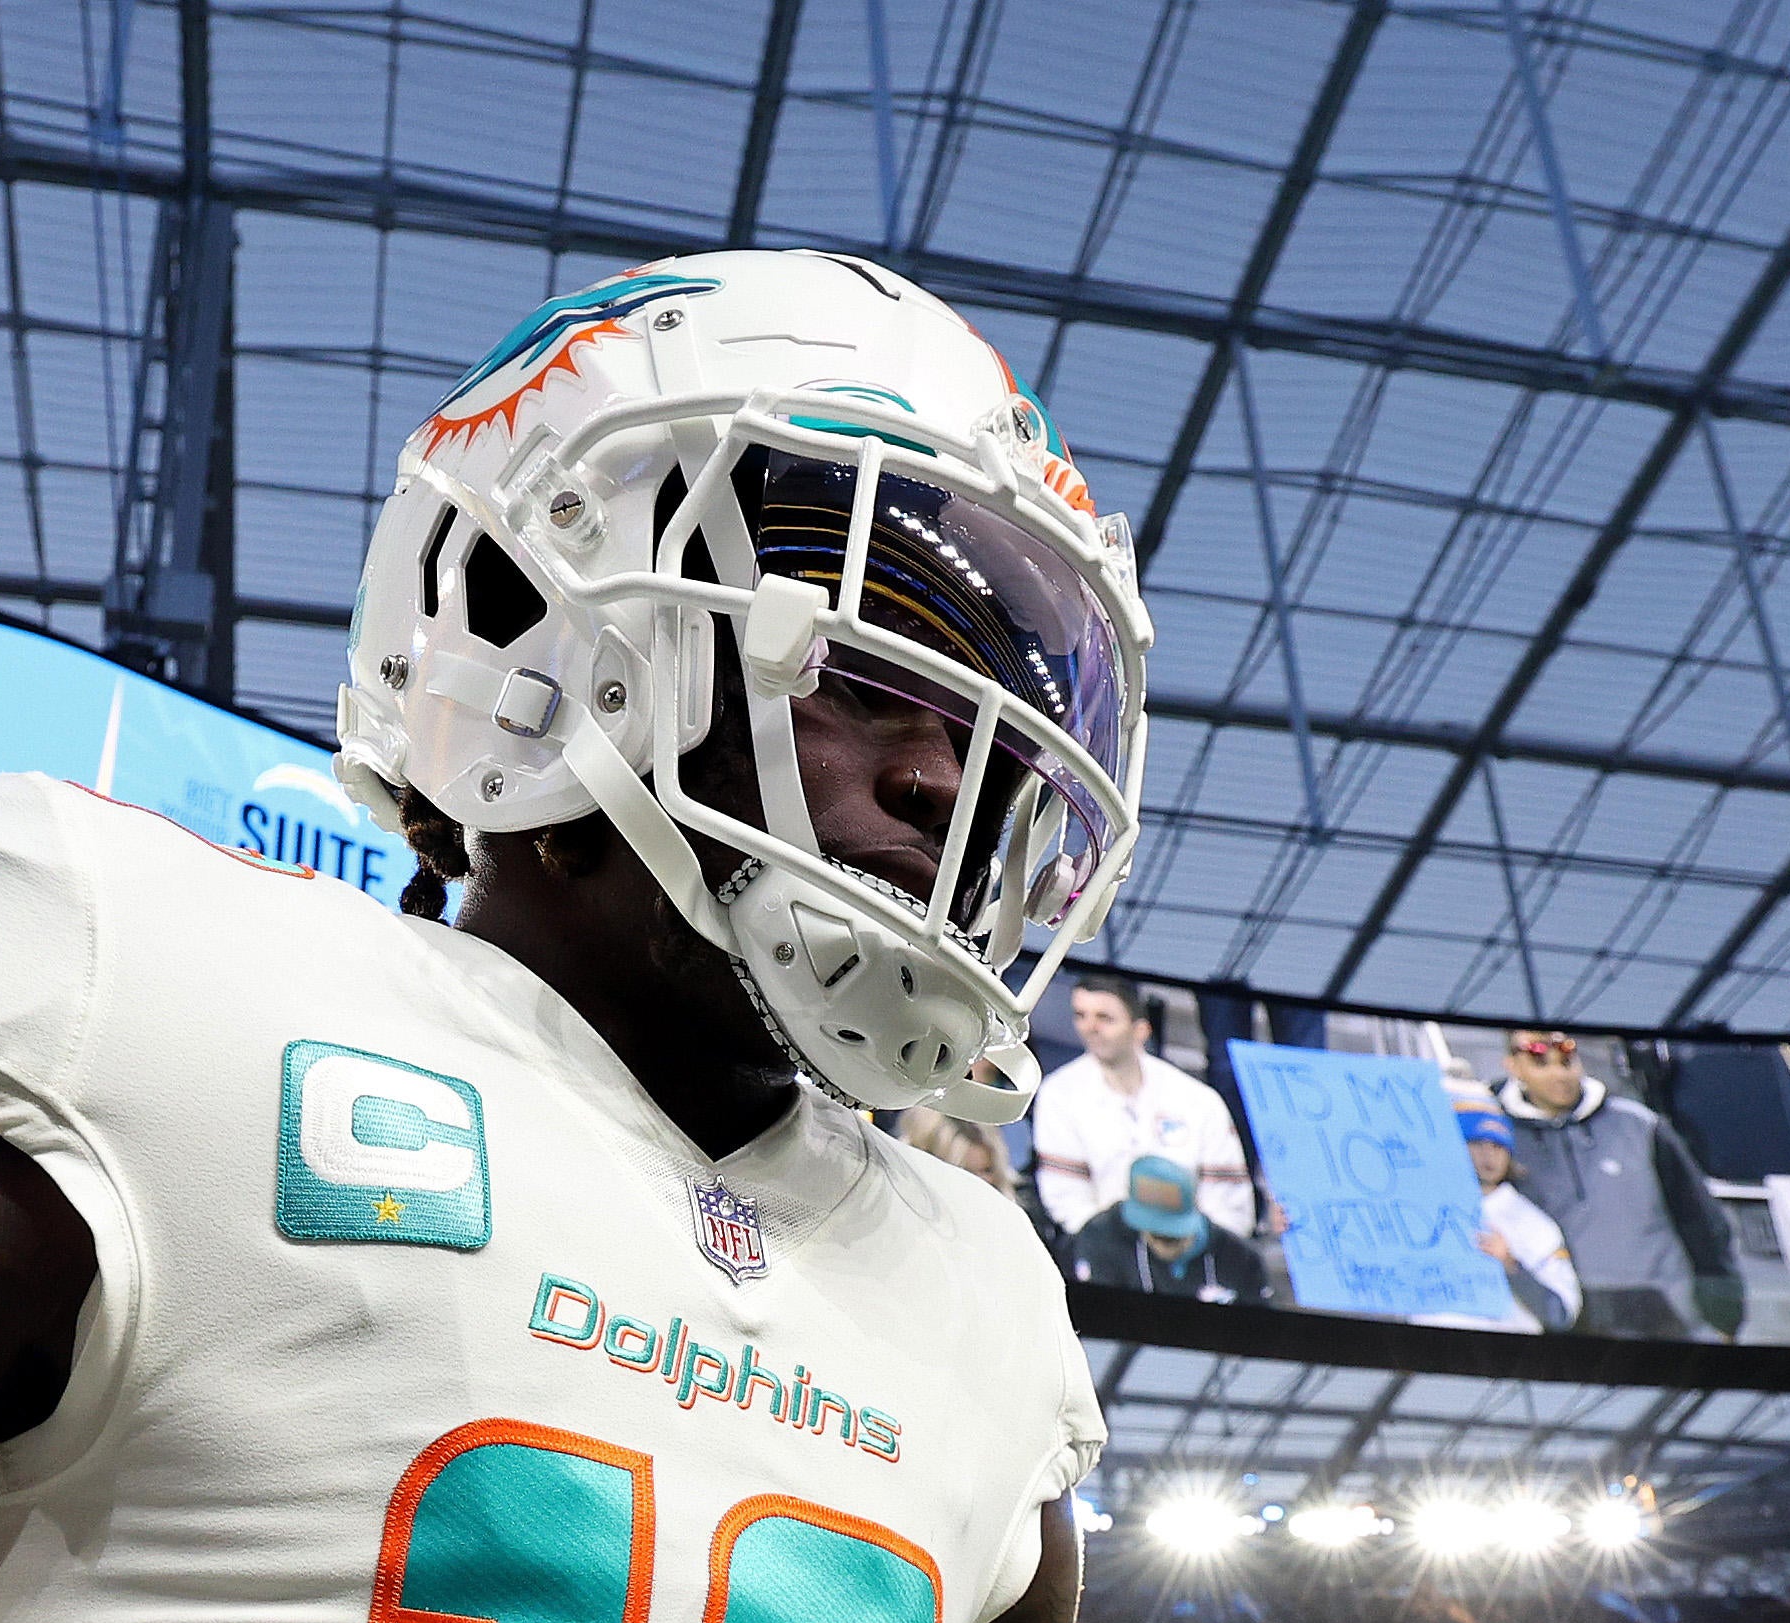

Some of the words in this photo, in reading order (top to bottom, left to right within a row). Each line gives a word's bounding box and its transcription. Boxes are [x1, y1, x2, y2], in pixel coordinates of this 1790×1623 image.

[238, 803, 386, 892] SUITE
[300, 1053, 477, 1192] C
[1344, 1071, 1437, 1139] MY
[706, 1216, 761, 1262] NFL
[528, 1272, 902, 1463] Dolphins
